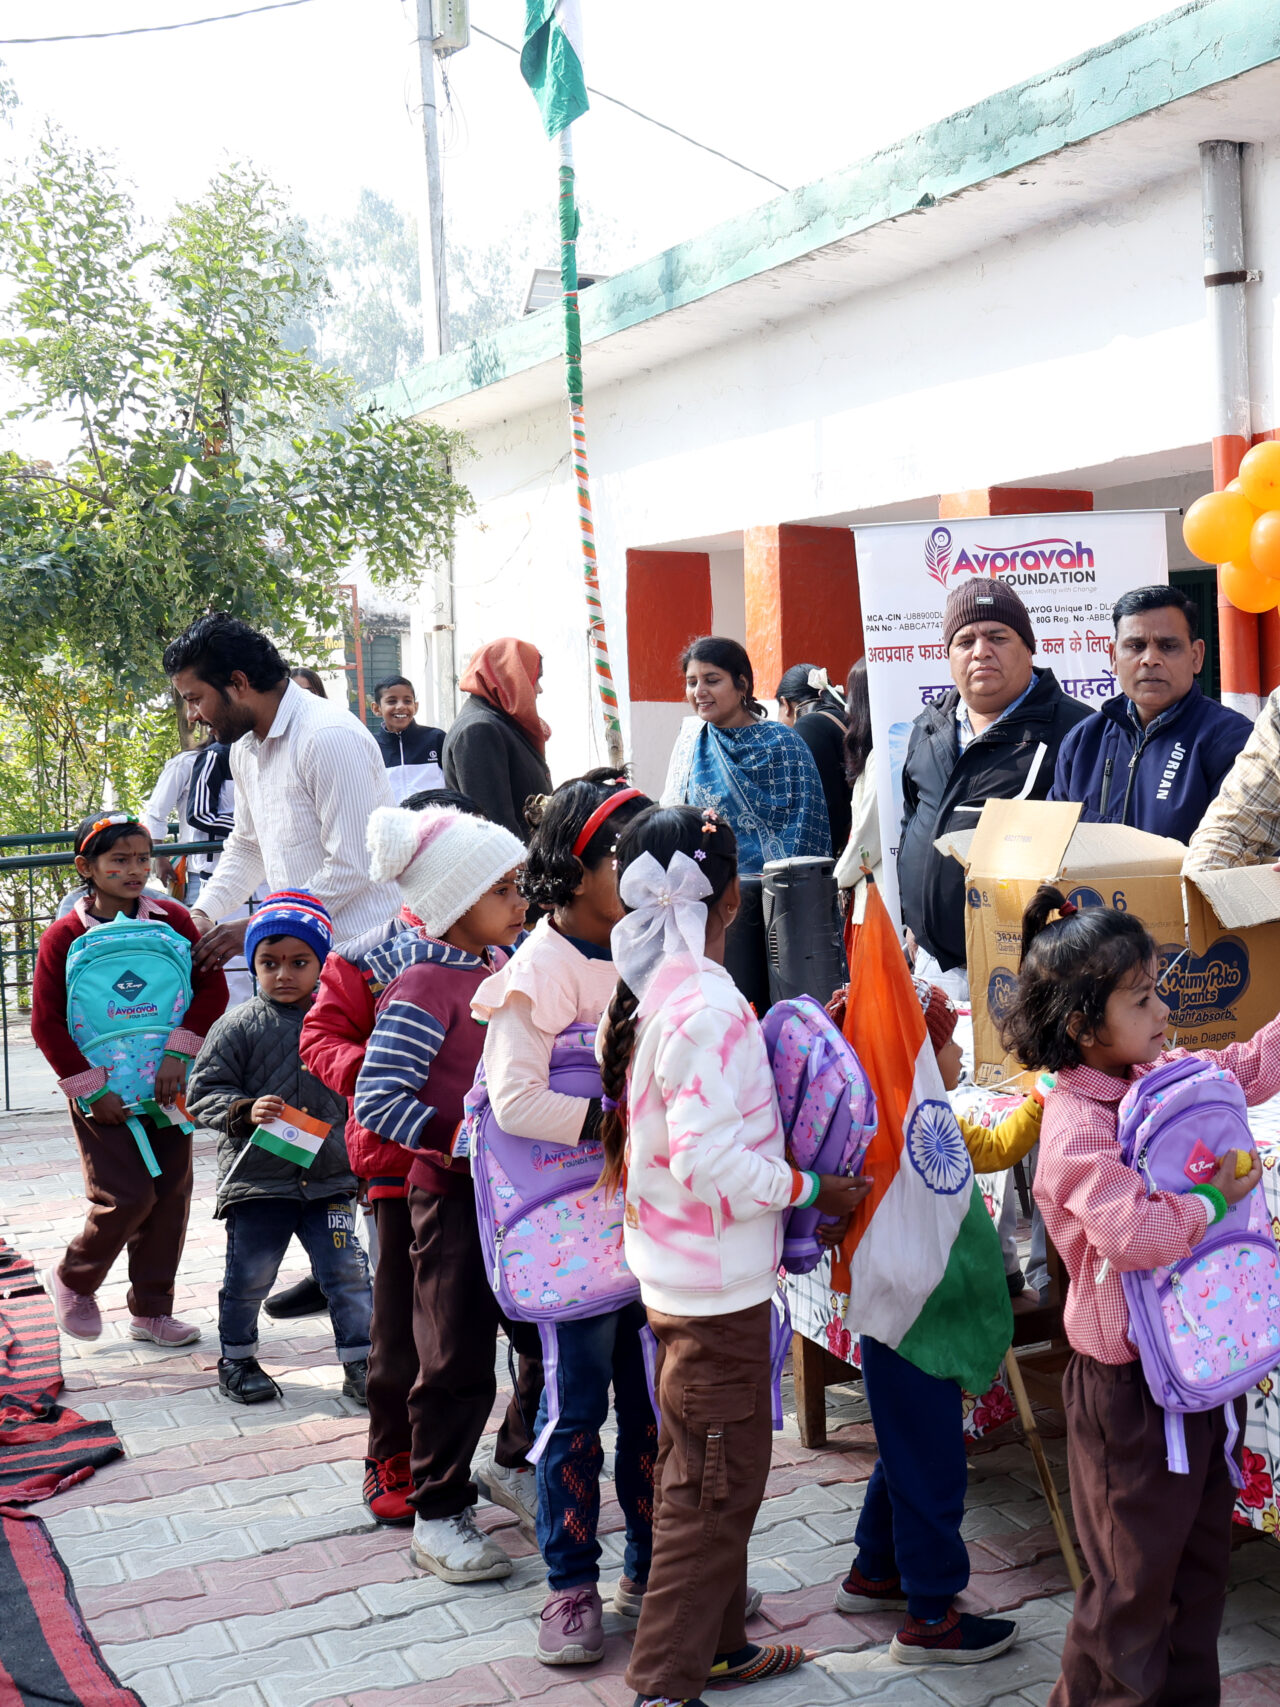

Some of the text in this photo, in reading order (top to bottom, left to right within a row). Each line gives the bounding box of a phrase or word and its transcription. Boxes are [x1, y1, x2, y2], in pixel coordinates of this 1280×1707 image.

[952, 541, 1095, 579] Avpravah
[998, 571, 1096, 586] FOUNDATION
[867, 613, 883, 622] MCA
[1055, 604, 1082, 614] Unique
[1084, 604, 1093, 612] ID
[1036, 614, 1085, 624] 80G Reg. No
[866, 624, 880, 633] PAN
[882, 624, 893, 632] No
[1041, 629, 1111, 654] कल के लिए
[868, 645, 914, 663] अवप्रवाह
[1061, 669, 1116, 699] पहलें
[1156, 742, 1186, 800] JORDAN
[982, 890, 989, 903] 6
[1112, 890, 1127, 912] 6
[1180, 989, 1218, 1008] pants
[115, 1003, 158, 1019] Avpravah
[1201, 1030, 1236, 1043] Diapers
[332, 1231, 347, 1249] 67
